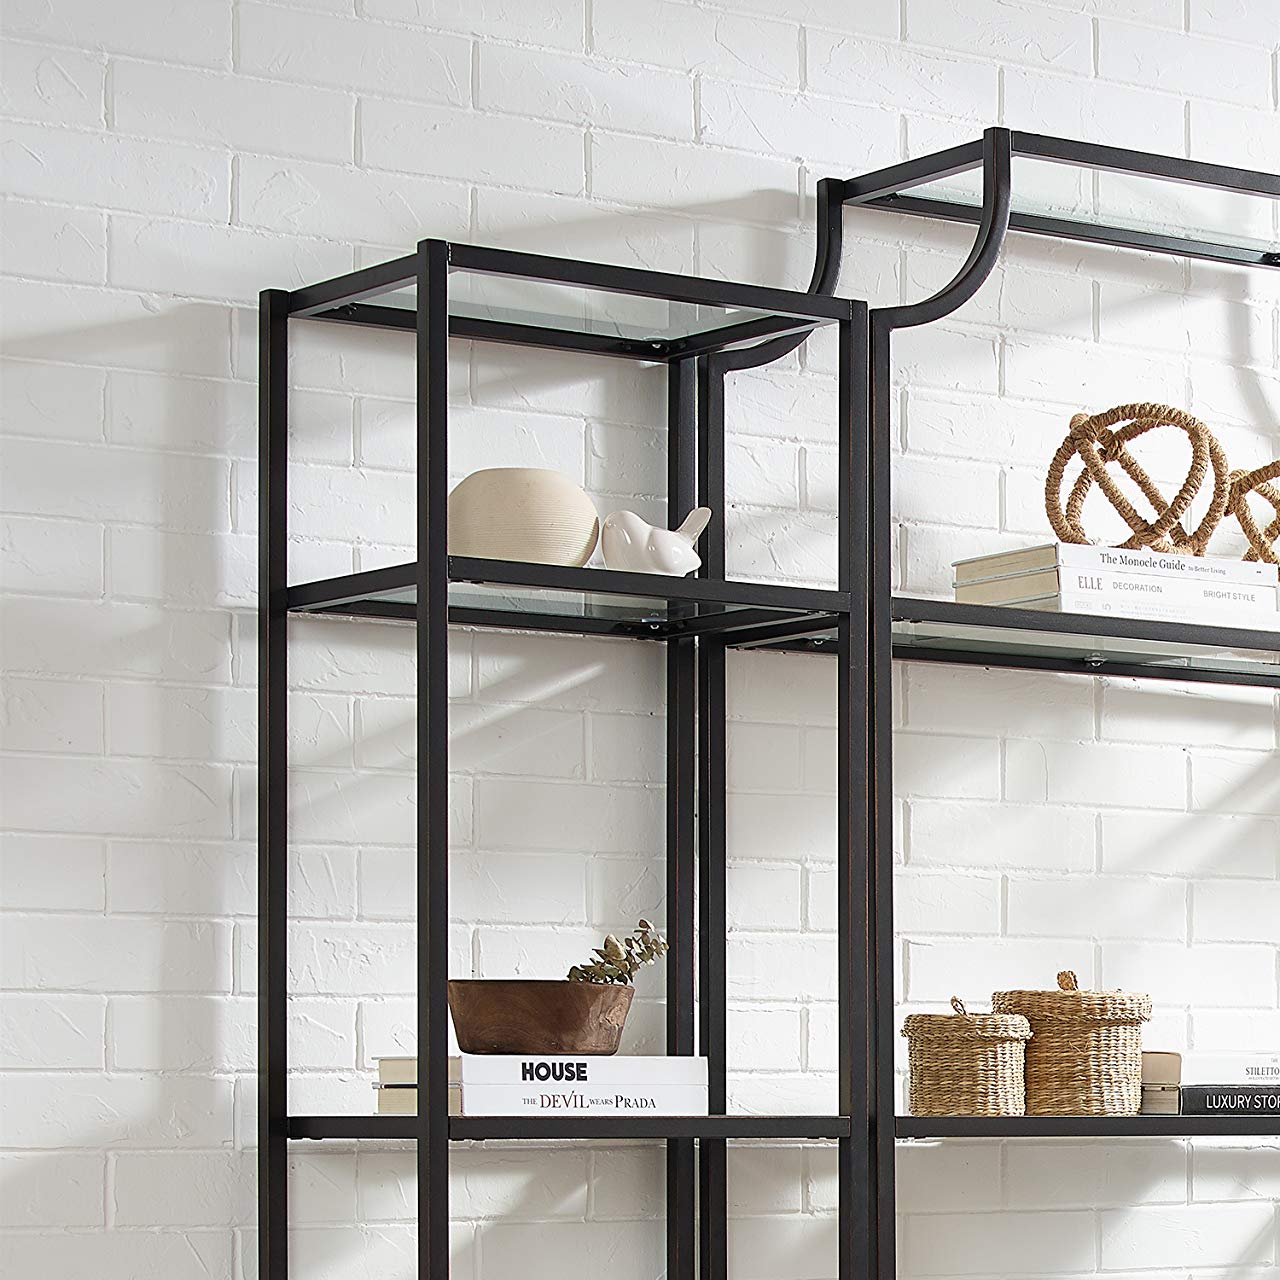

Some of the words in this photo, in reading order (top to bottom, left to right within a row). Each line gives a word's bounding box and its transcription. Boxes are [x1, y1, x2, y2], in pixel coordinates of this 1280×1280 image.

[1100, 553, 1118, 565] The
[1119, 554, 1158, 570] Monocle
[1159, 558, 1186, 572] Guide
[1078, 575, 1103, 591] ELLE
[1112, 581, 1163, 593] DECORATION
[1203, 589, 1231, 601] BRIGHT
[1232, 591, 1256, 602] STYLE
[521, 1062, 588, 1081] HOUSE
[1245, 1066, 1280, 1076] STILETTO
[522, 1097, 538, 1105] THE
[540, 1090, 590, 1109] DEVIL
[589, 1098, 614, 1106] WEARS
[614, 1094, 657, 1109] PRADA
[1206, 1094, 1252, 1109] LUXURY
